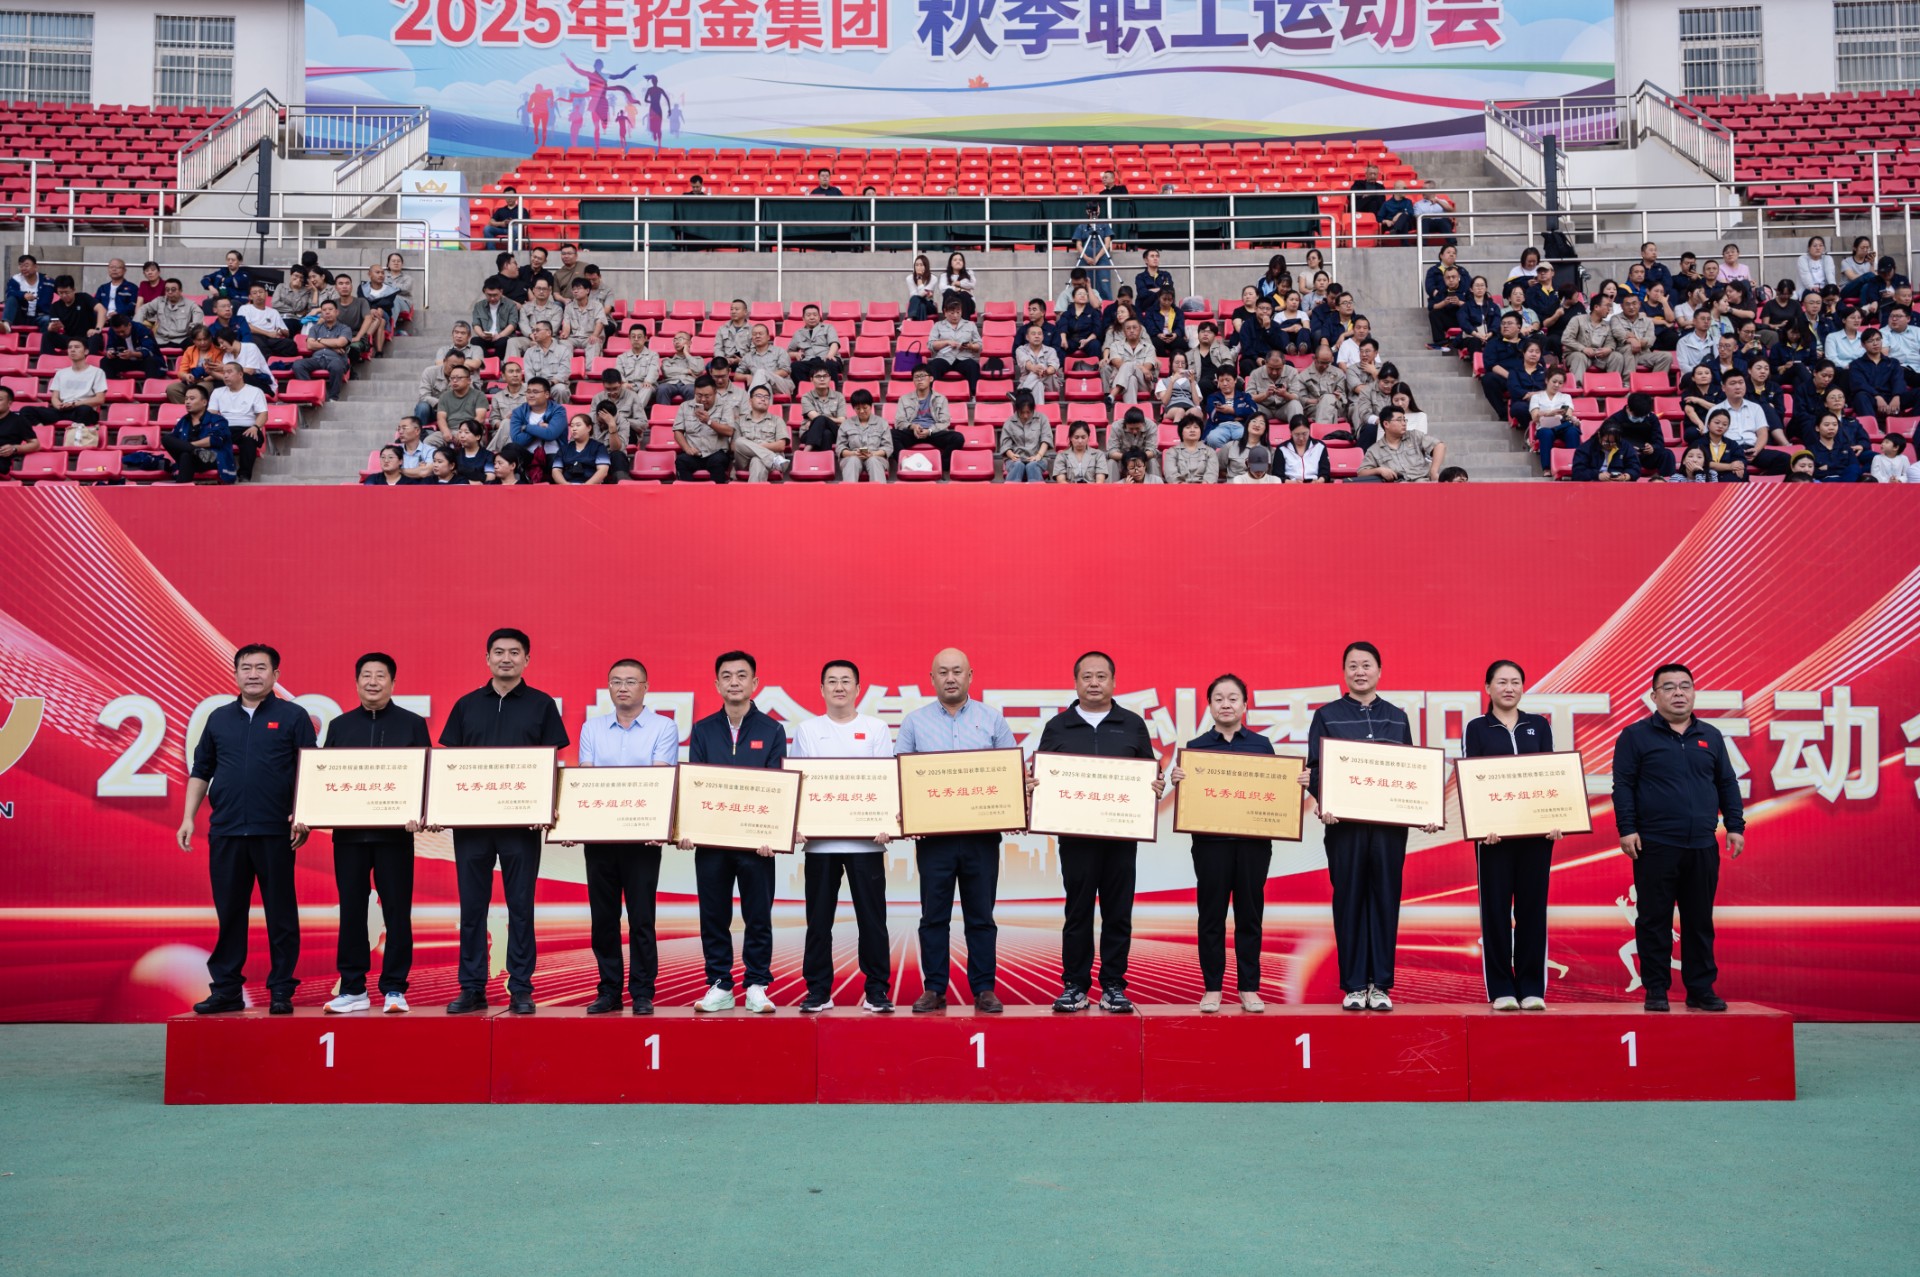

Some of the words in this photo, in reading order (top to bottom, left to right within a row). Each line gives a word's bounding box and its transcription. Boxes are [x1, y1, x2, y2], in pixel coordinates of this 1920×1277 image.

[394, 0, 889, 49] 2025年招金集团
[916, 0, 1502, 56] 秋季职工运动会
[325, 782, 396, 792] 优秀组织奖
[456, 781, 527, 791] 优秀组织奖
[1348, 775, 1418, 790] 优秀组织奖
[808, 792, 878, 802] 优秀组织奖
[927, 785, 999, 798] 优秀组织奖
[1058, 789, 1131, 804] 优秀组织奖
[1204, 787, 1276, 802] 优秀组织奖
[1488, 789, 1559, 802] 优秀组织奖
[577, 799, 647, 809] 优秀组织奖
[701, 800, 770, 815] 优秀组织奖
[319, 1031, 335, 1067] 1
[644, 1034, 660, 1070] 1
[969, 1032, 985, 1068] 1
[1295, 1033, 1311, 1069] 1
[1621, 1031, 1637, 1067] 1
